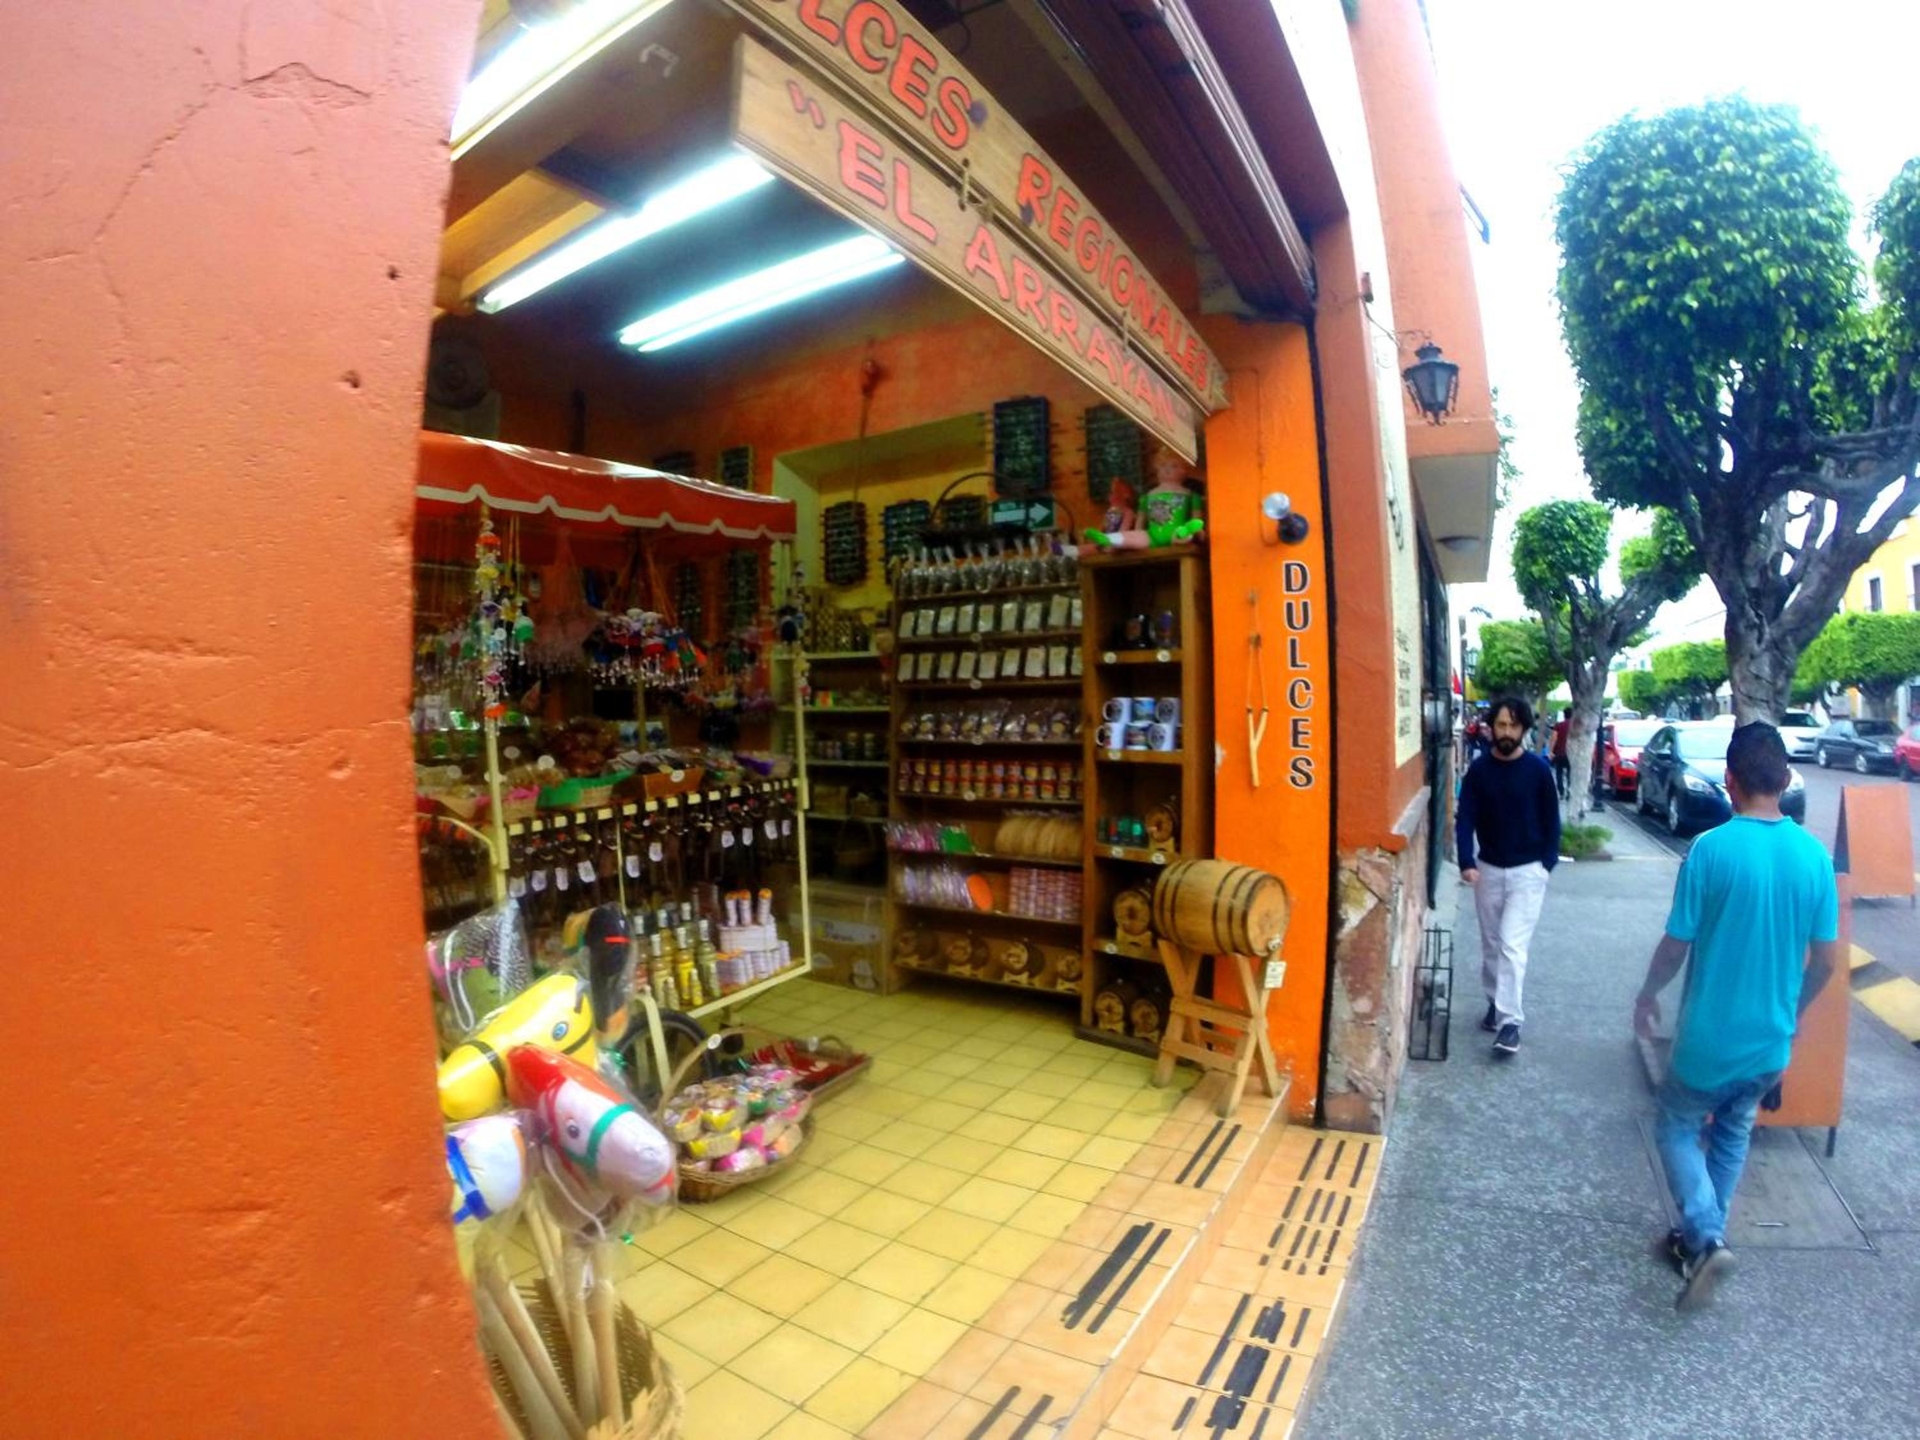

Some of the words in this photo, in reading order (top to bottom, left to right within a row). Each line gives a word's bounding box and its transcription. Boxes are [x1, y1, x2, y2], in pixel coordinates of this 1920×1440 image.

[769, 0, 972, 150] LCES
[1017, 153, 1208, 391] REGIONALES
[1283, 561, 1316, 789] DULCES
